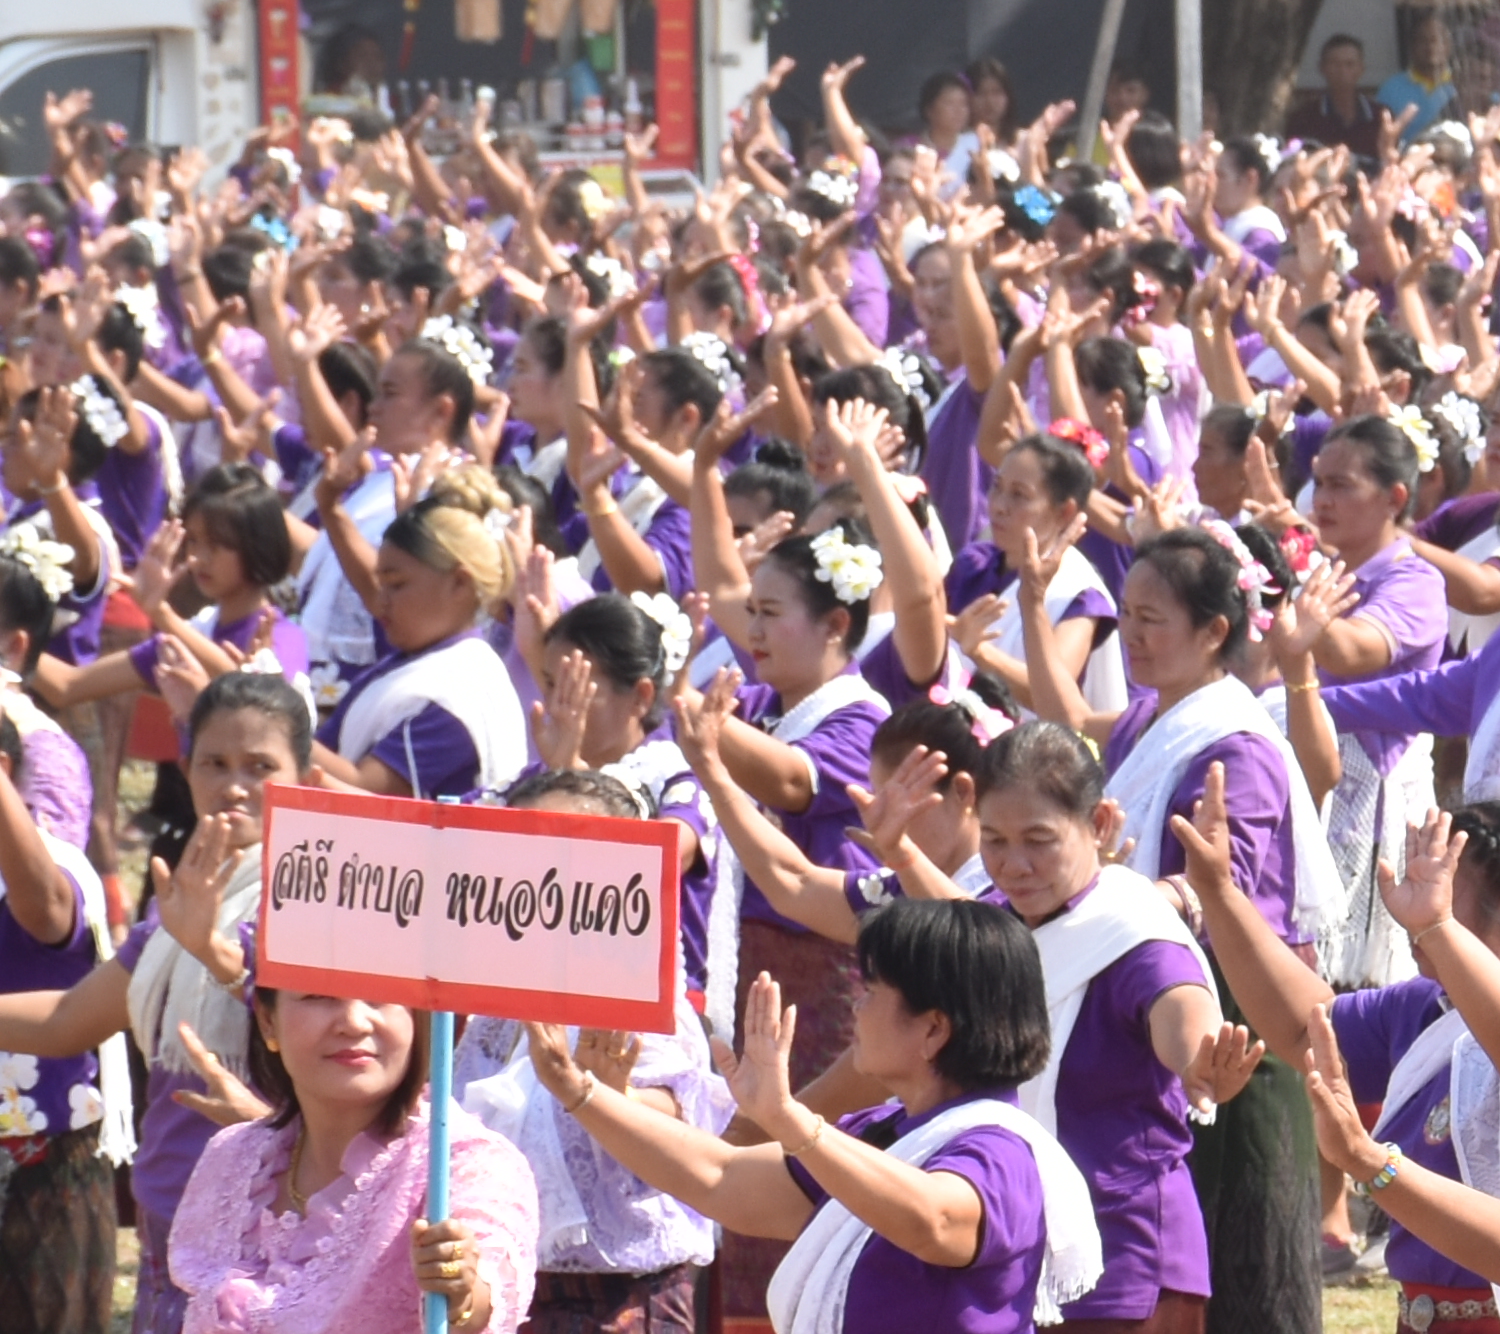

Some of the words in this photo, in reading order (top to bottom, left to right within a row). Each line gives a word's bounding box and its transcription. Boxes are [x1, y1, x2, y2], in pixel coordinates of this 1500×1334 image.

[337, 853, 425, 928] ตำบล
[446, 867, 651, 941] หนองแดง
